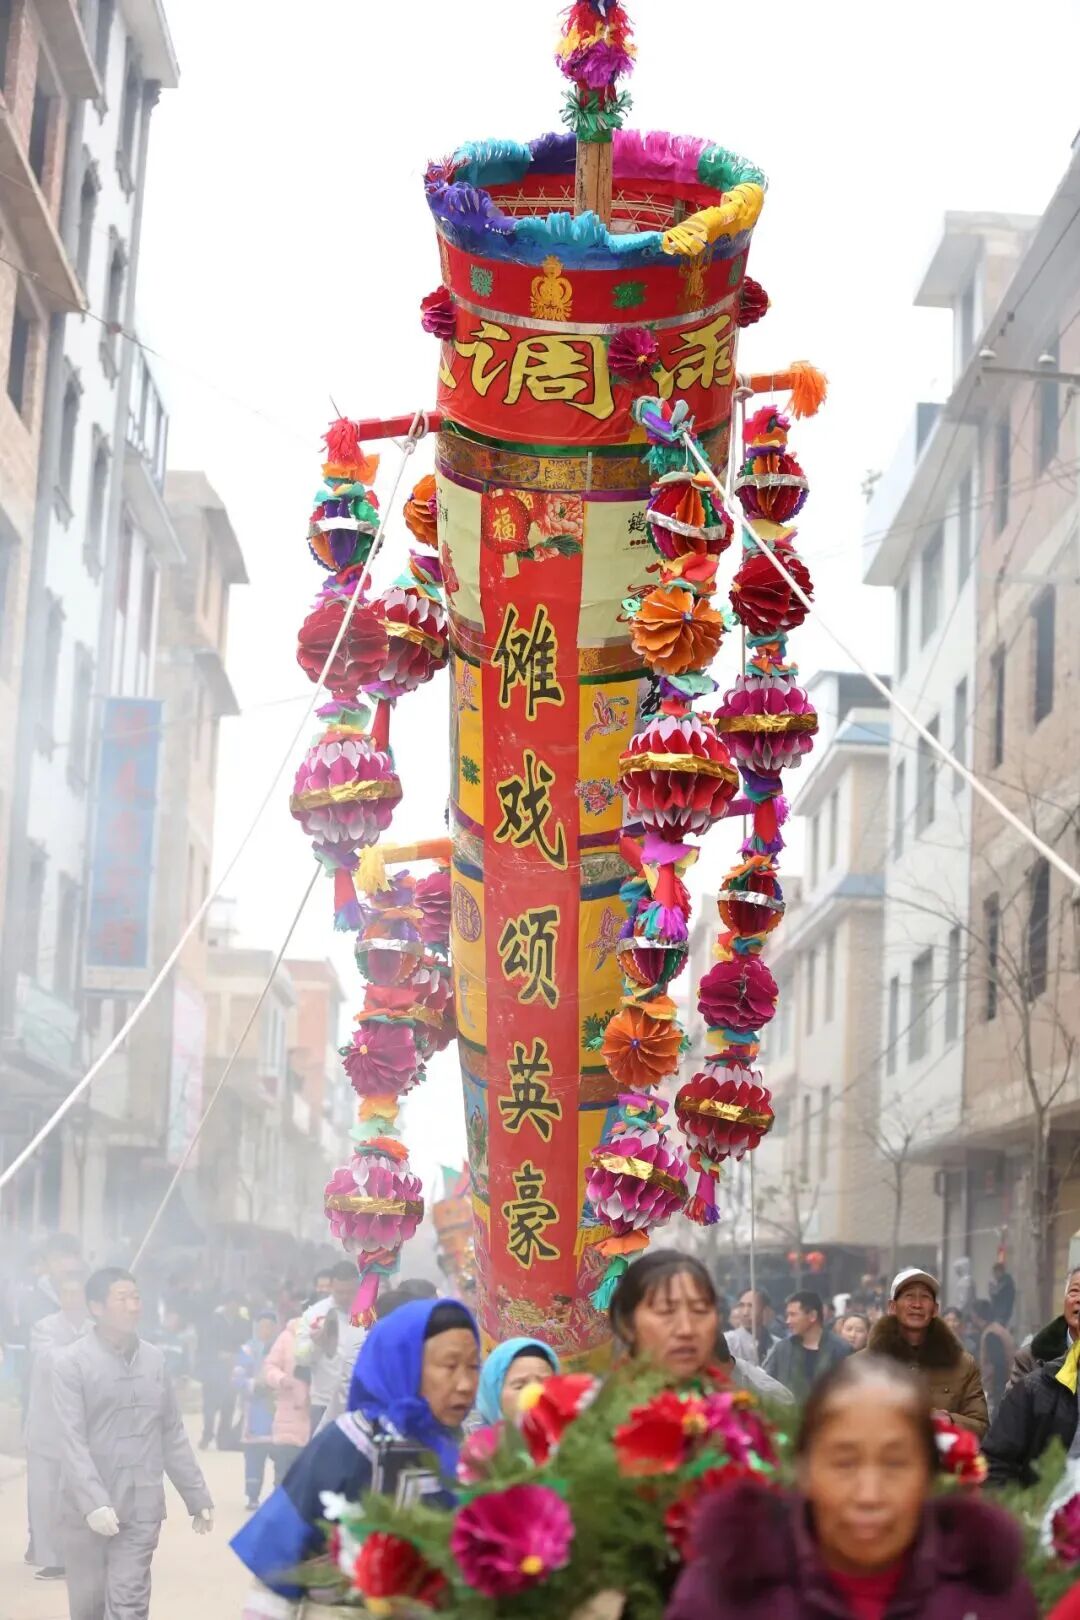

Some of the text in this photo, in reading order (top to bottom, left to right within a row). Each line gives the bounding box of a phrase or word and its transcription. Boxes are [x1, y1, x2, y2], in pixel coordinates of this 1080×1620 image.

[439, 314, 735, 420] 调雨
[492, 507, 517, 543] 福
[491, 602, 568, 1271] 傩戏颂英豪
